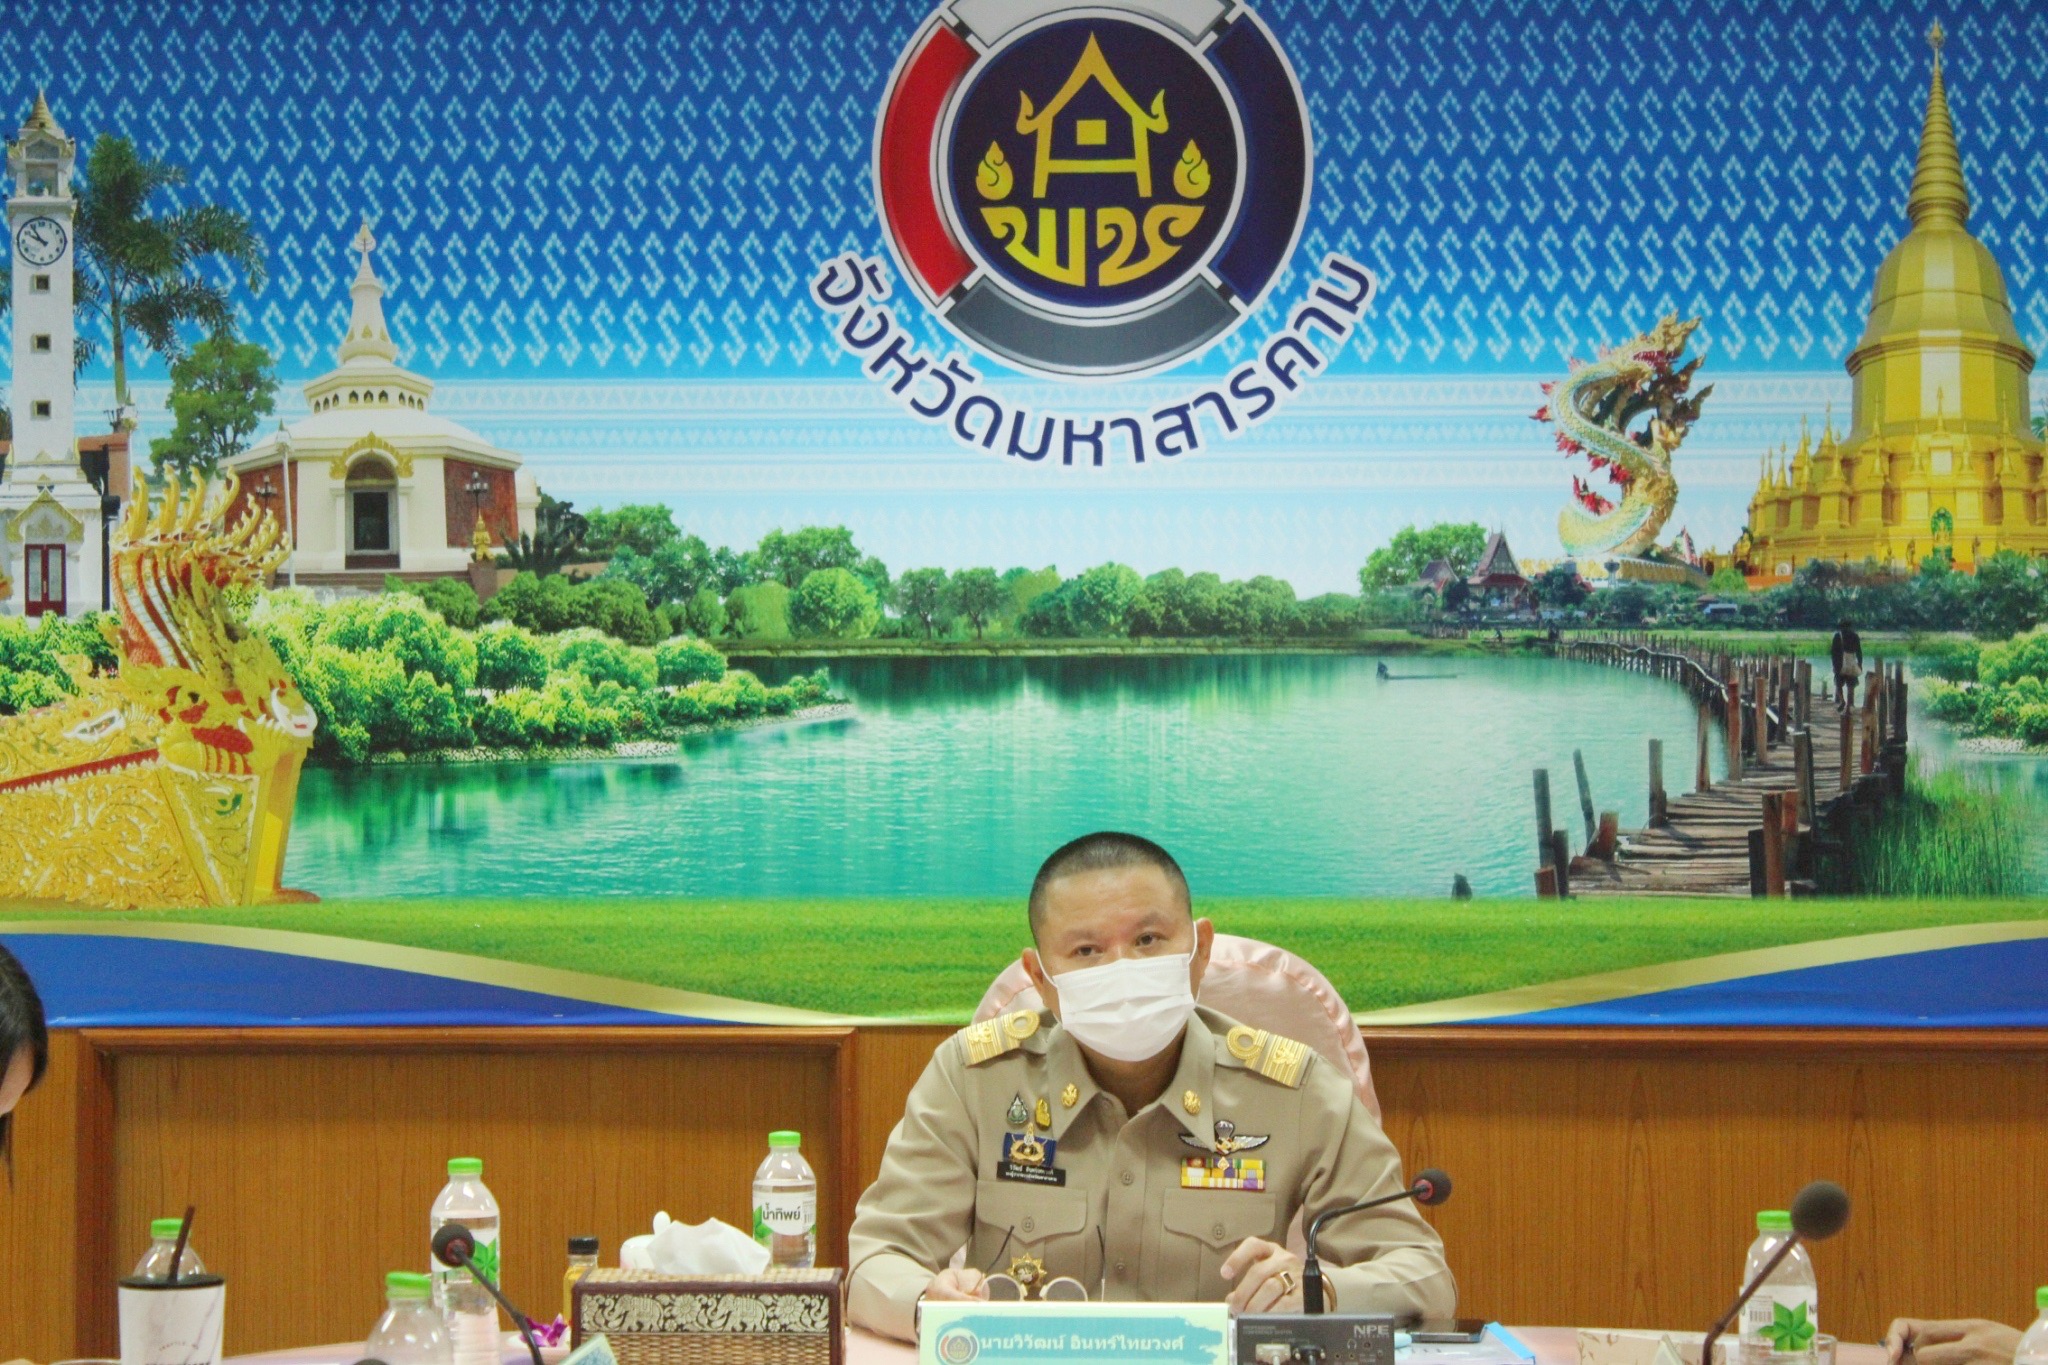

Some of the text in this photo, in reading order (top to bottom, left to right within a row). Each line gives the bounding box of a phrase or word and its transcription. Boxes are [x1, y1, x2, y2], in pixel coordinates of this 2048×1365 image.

[816, 258, 1371, 467] จังหวัดมหาสารคาม
[762, 1202, 801, 1221] น้ำทิพย์
[1354, 1324, 1390, 1335] NPE
[981, 1333, 1184, 1350] นายวิวัฒน์ อินทร์ไทยวงศ์
